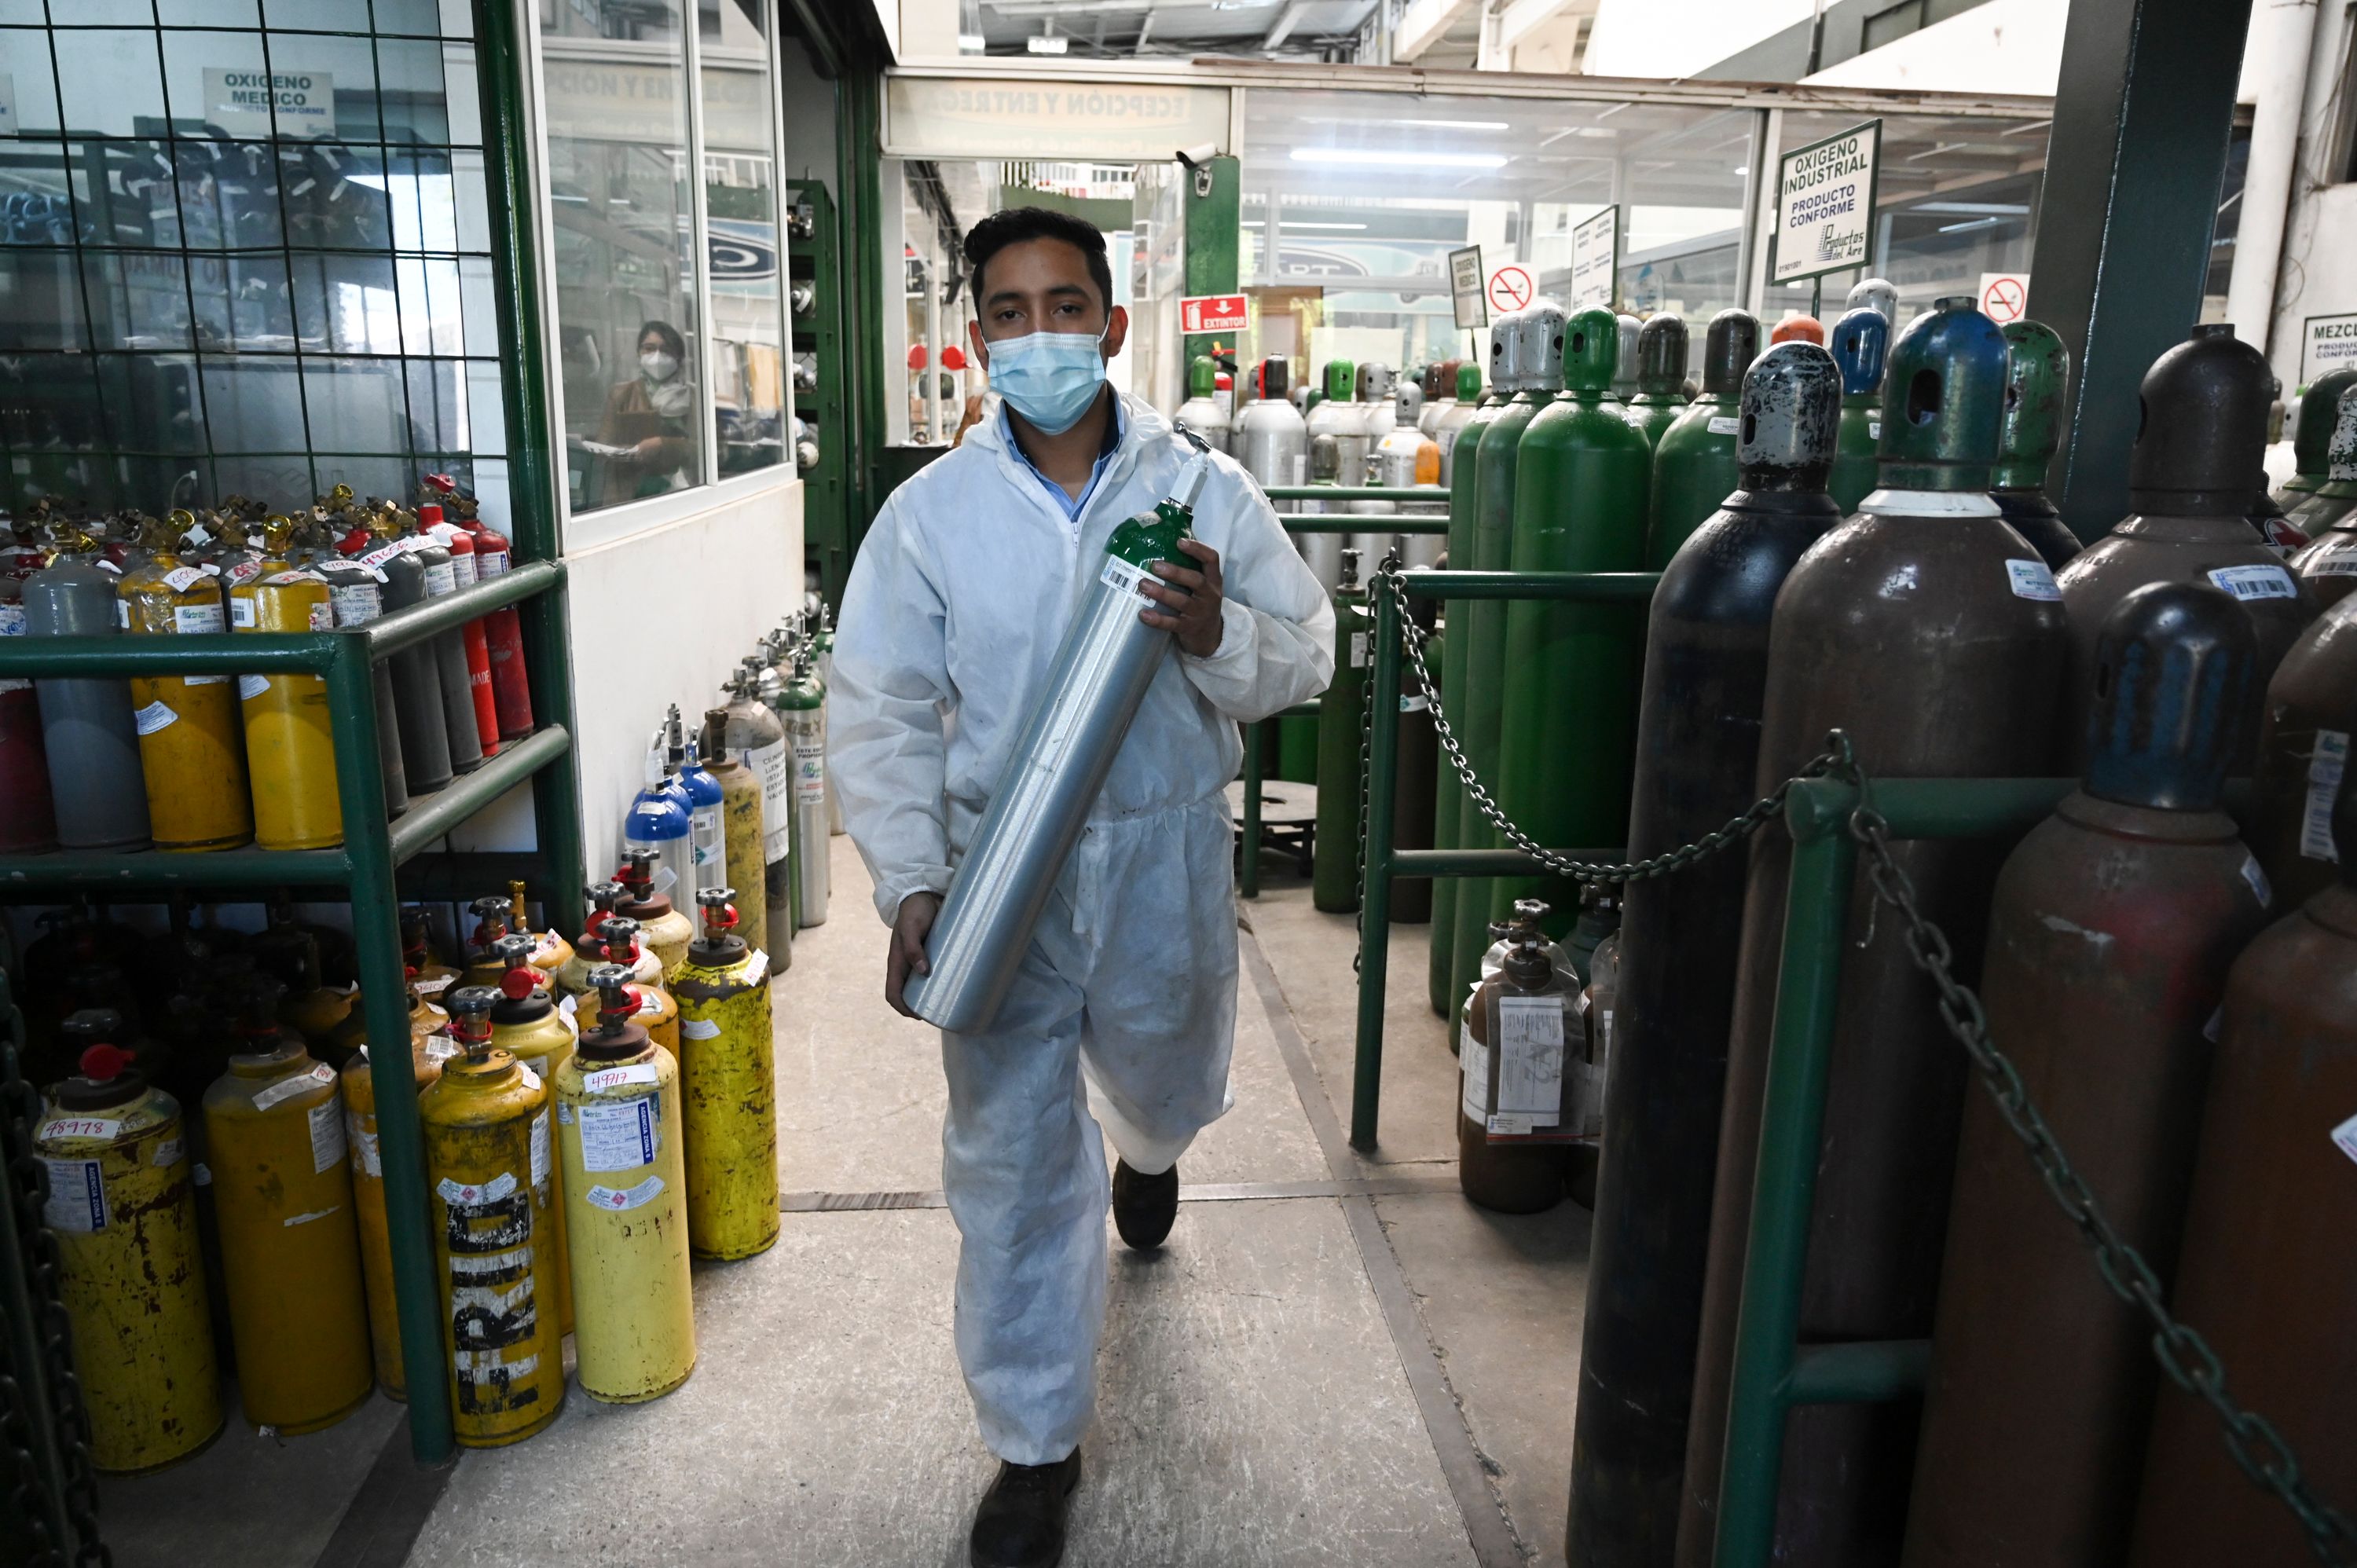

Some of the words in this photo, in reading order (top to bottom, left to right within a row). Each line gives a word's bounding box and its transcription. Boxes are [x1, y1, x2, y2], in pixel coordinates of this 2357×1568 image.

[225, 74, 312, 90] OXIGENO
[232, 91, 306, 105] MEDICO
[1795, 137, 1858, 174] OXIGENO
[1784, 153, 1868, 196] INDUSTRIAL
[1791, 184, 1856, 214] PRODUCTO
[1790, 199, 1855, 229] CONFORME
[1204, 316, 1245, 330] EXTINTOR
[592, 1072, 628, 1088] 49717
[46, 1120, 104, 1138] 48978
[88, 1167, 98, 1199] AGENCIA
[92, 1199, 101, 1218] ZONA
